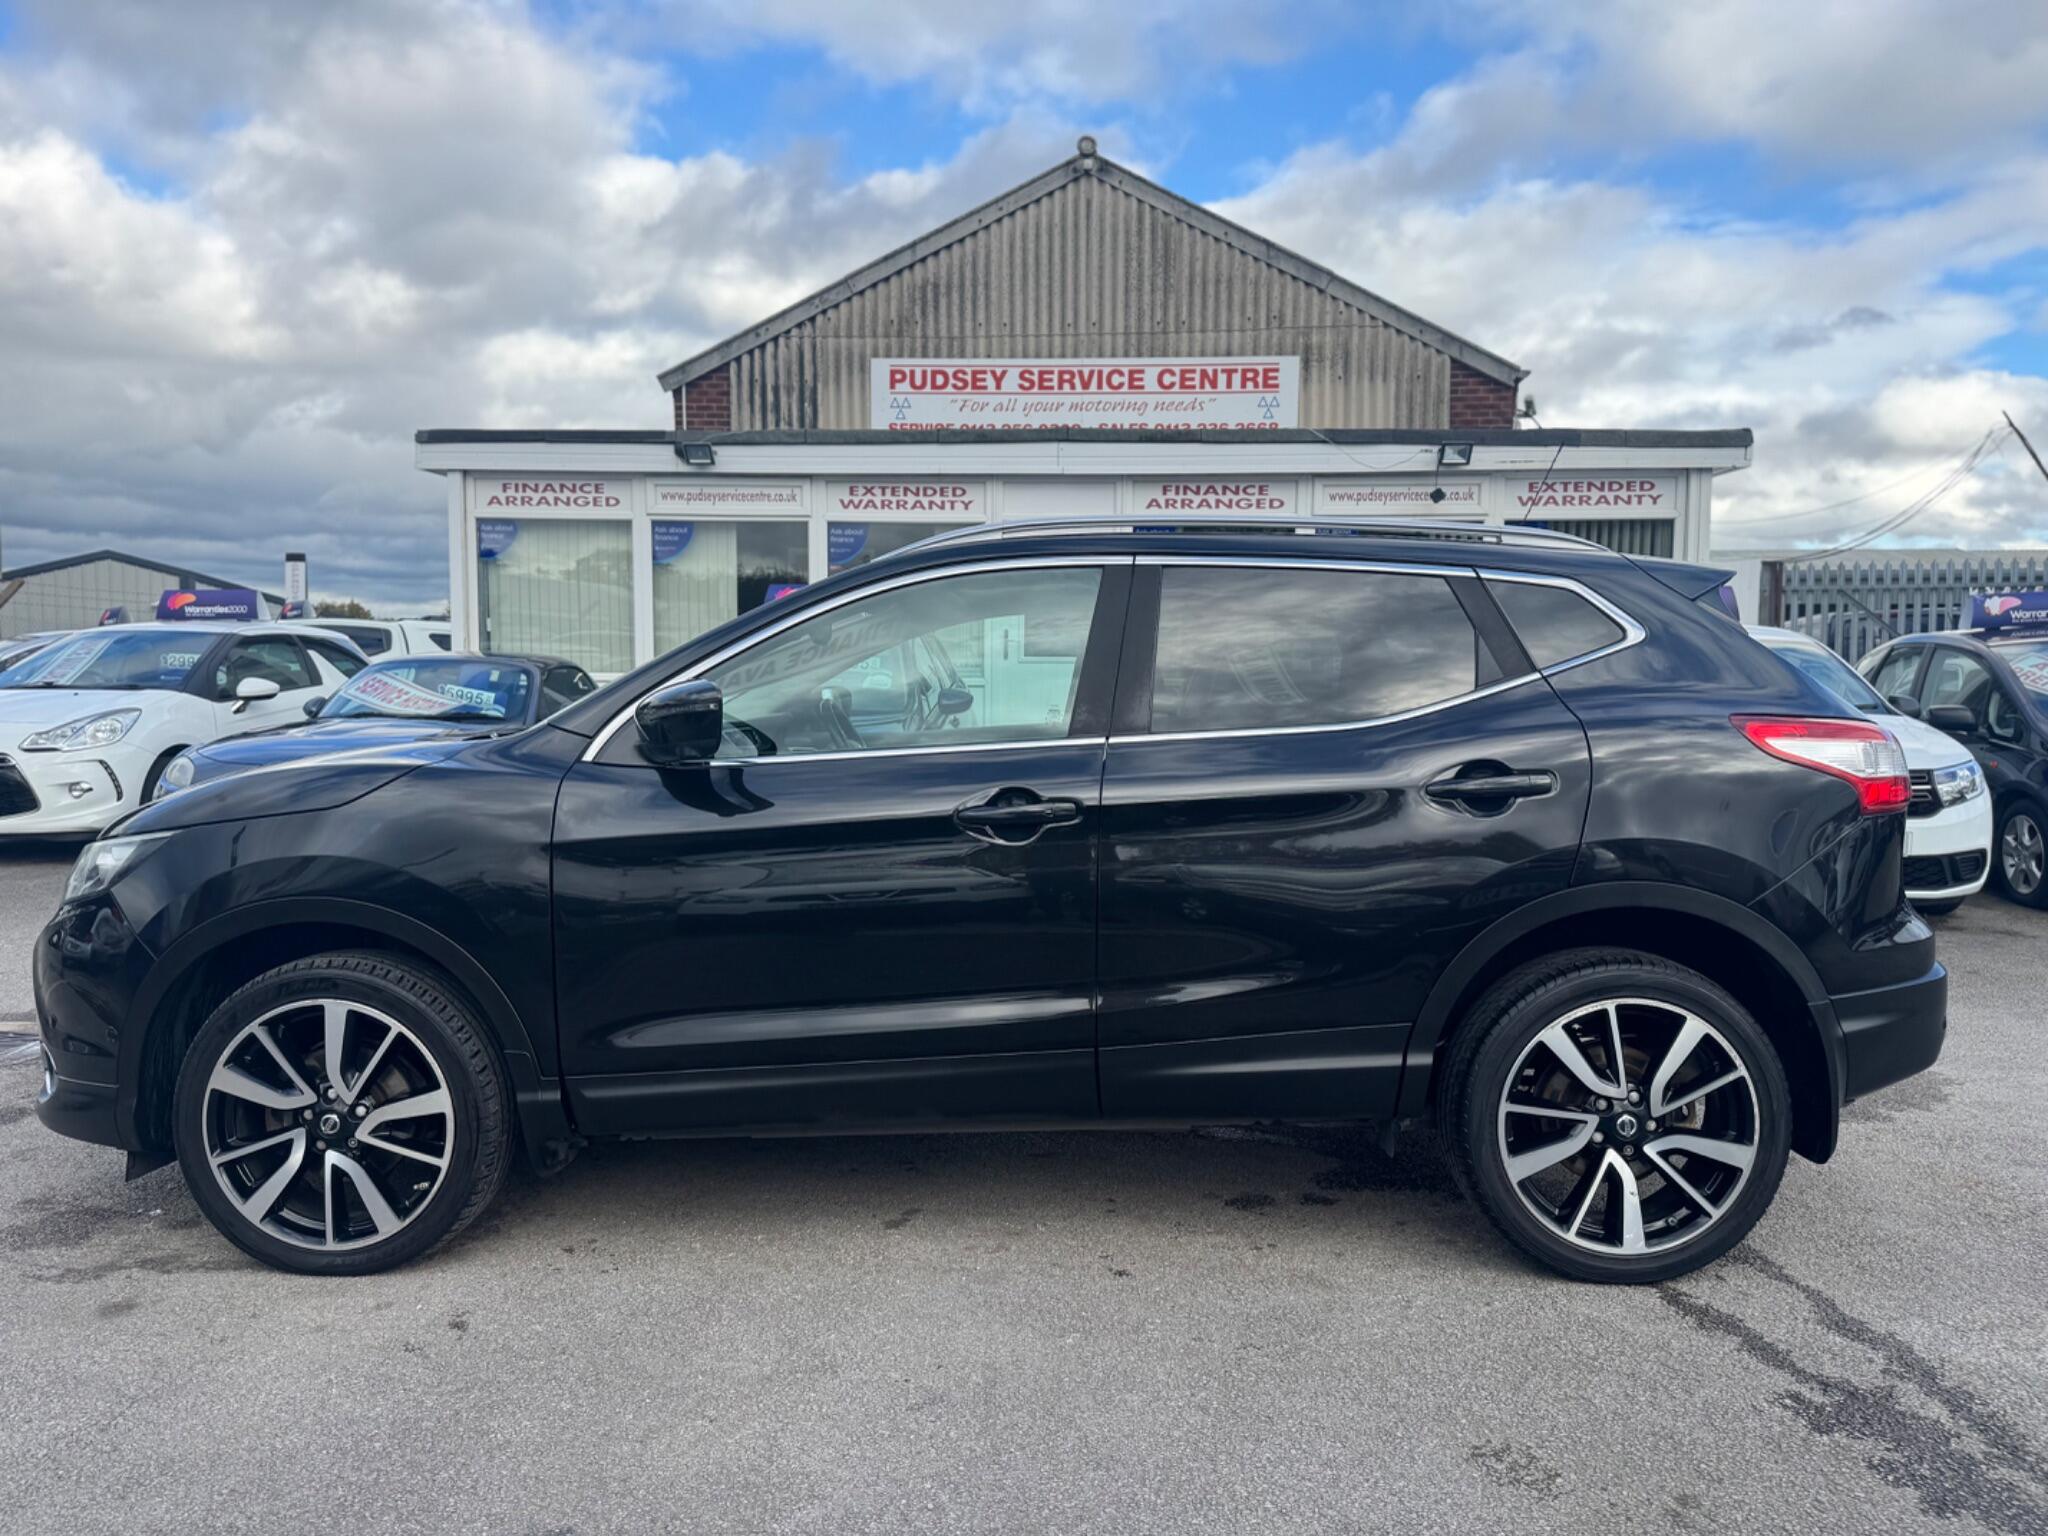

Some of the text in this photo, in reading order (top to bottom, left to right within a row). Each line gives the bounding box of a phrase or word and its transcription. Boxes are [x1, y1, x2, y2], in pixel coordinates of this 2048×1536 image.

[889, 366, 1280, 391] PUDSEY SERVICE CENTRE
[993, 398, 1017, 412] all
[1022, 401, 1064, 417] your
[1068, 399, 1149, 417] motoring
[501, 482, 605, 494] FINANCE
[848, 484, 967, 498] EXTENDED
[1161, 484, 1270, 497] FINANCE
[1527, 480, 1656, 493] EXTENDED
[487, 495, 621, 507] ARRANGED
[661, 488, 798, 506] www.pudseyservicecentre.co.uk
[1328, 486, 1475, 506] www.pudseyservicece.co.uk
[1517, 494, 1663, 507] WARRANTY
[839, 499, 974, 511] WARRANTY
[1145, 497, 1285, 510] ARRANGED
[184, 605, 248, 614] Warranties2000
